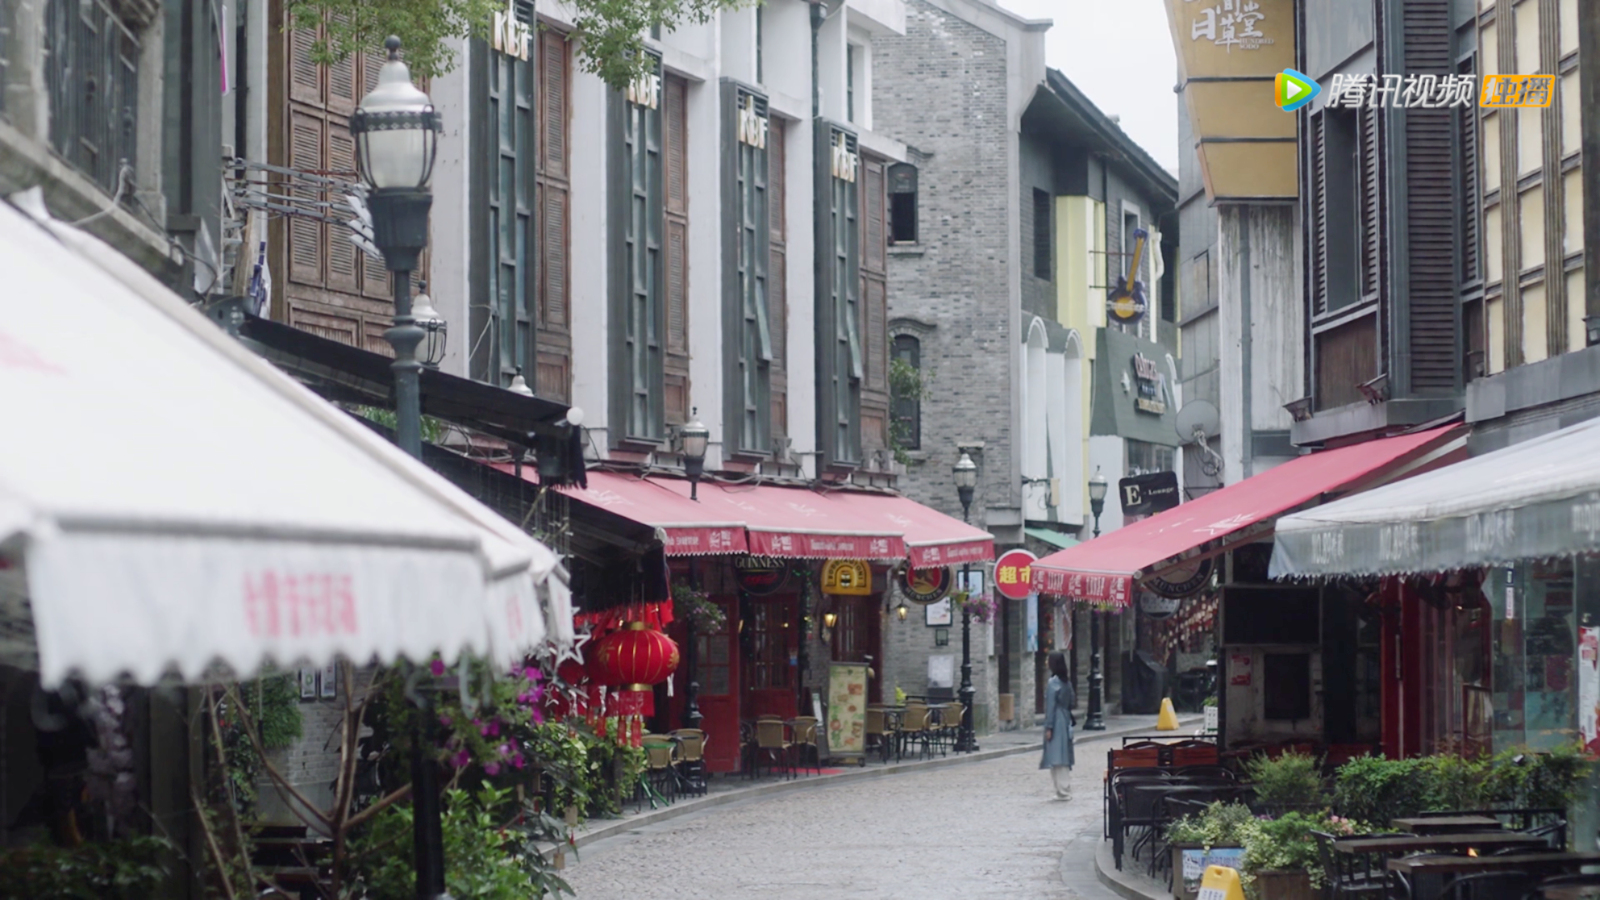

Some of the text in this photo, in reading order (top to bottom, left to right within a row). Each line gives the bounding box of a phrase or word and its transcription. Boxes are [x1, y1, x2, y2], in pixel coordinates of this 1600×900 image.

[1124, 484, 1175, 507] E Lounge
[734, 556, 785, 569] GUINNESS
[999, 565, 1031, 584] 超市
